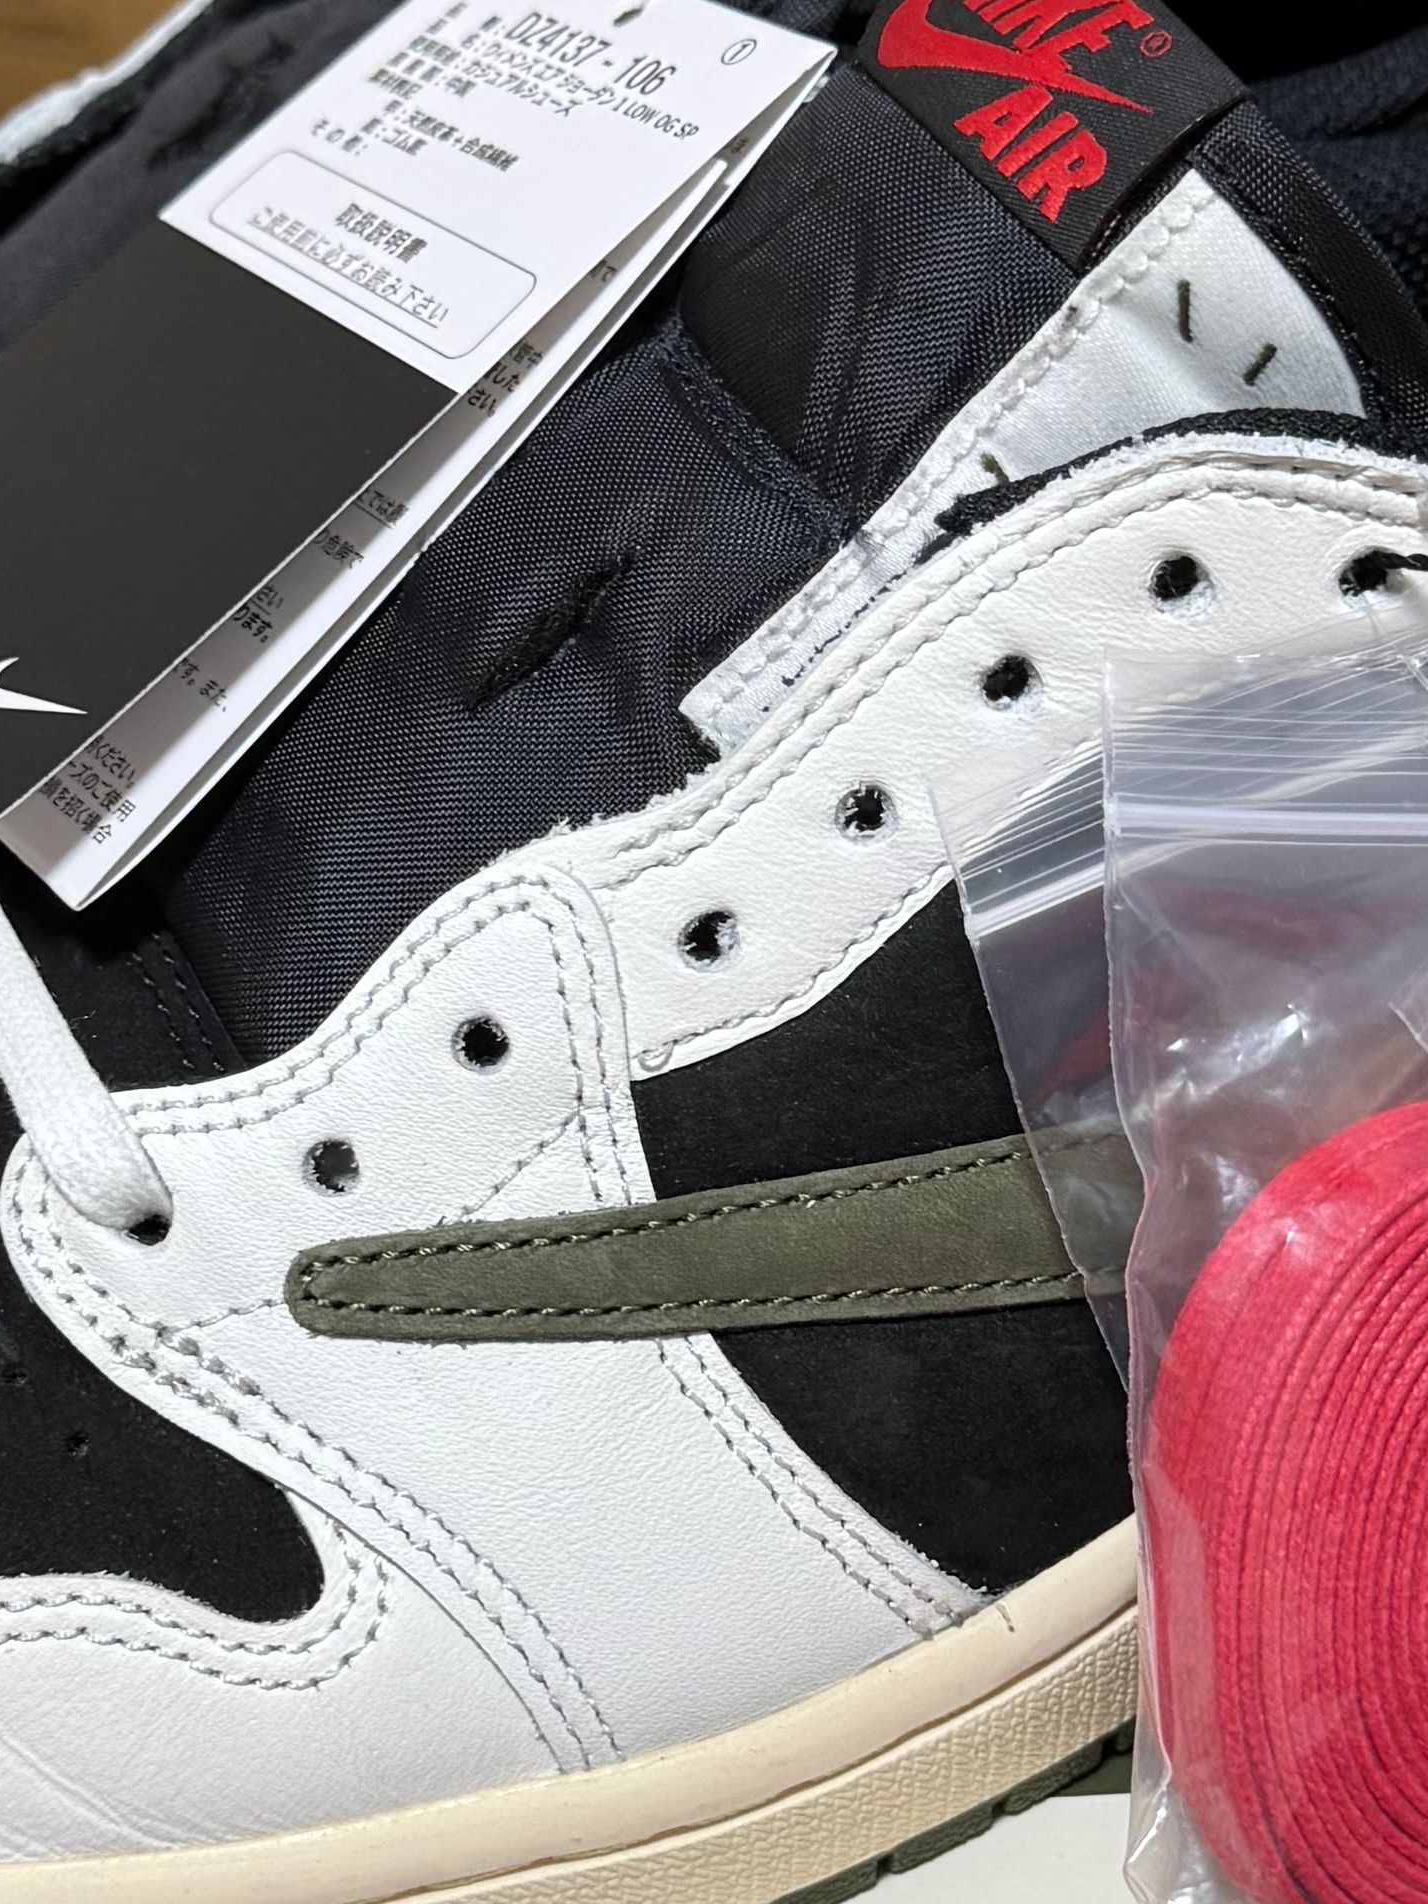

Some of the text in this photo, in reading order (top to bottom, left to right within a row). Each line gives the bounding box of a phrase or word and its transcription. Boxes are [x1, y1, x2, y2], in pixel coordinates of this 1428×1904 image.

[953, 83, 1107, 223] AIR
[334, 202, 429, 264] 取扱説明書
